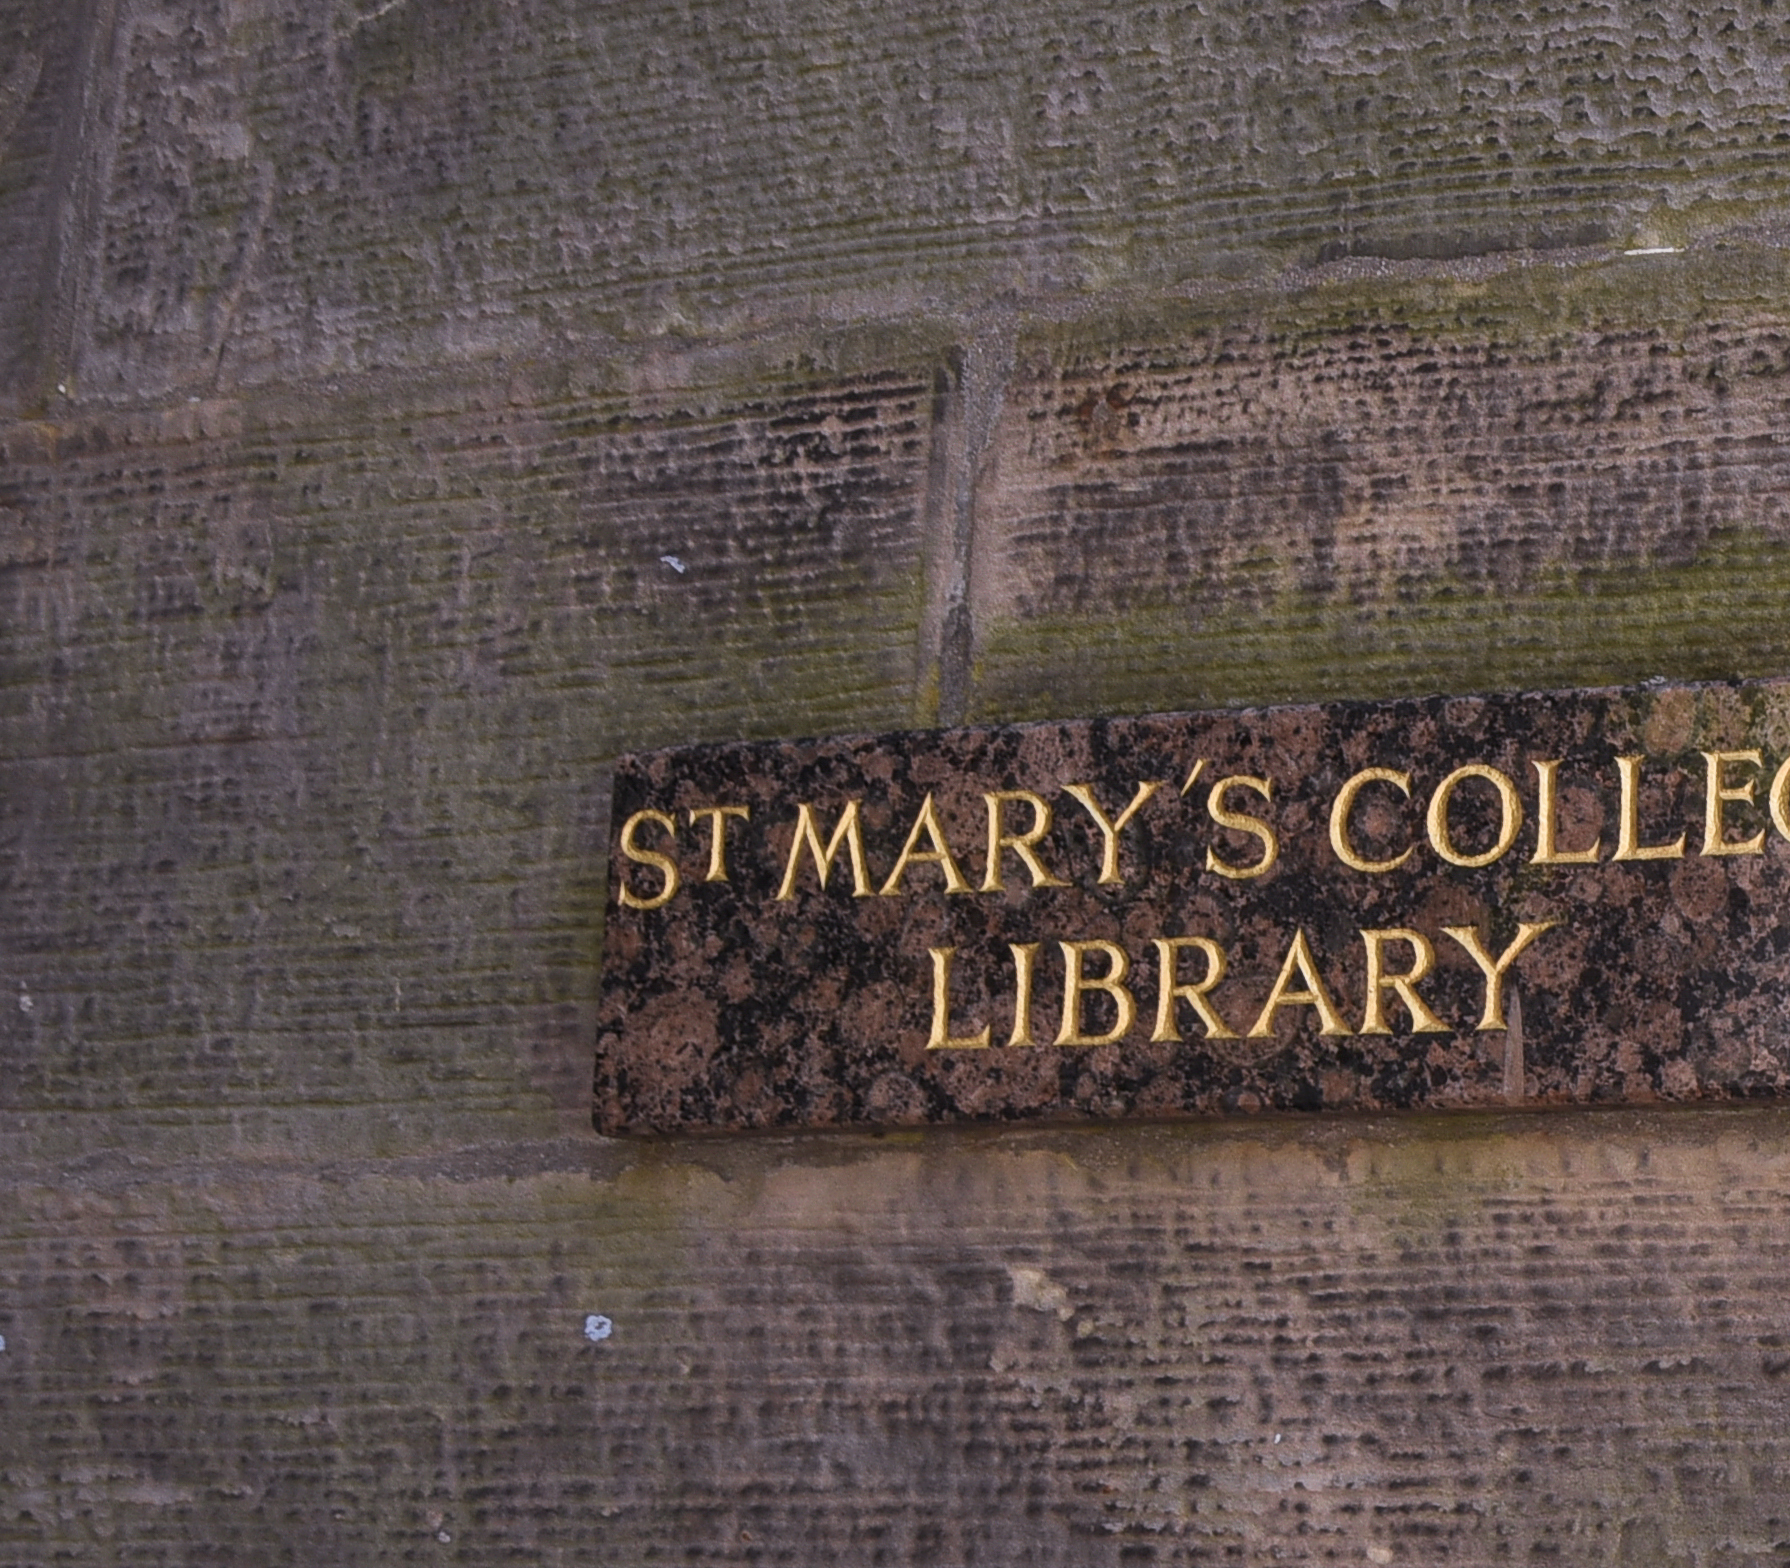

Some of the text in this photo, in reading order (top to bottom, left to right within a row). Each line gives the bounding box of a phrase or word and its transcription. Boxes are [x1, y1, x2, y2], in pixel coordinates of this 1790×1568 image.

[617, 804, 750, 910] ST
[775, 757, 1280, 901] MARY'S
[924, 919, 1560, 1051] LIBRARY
